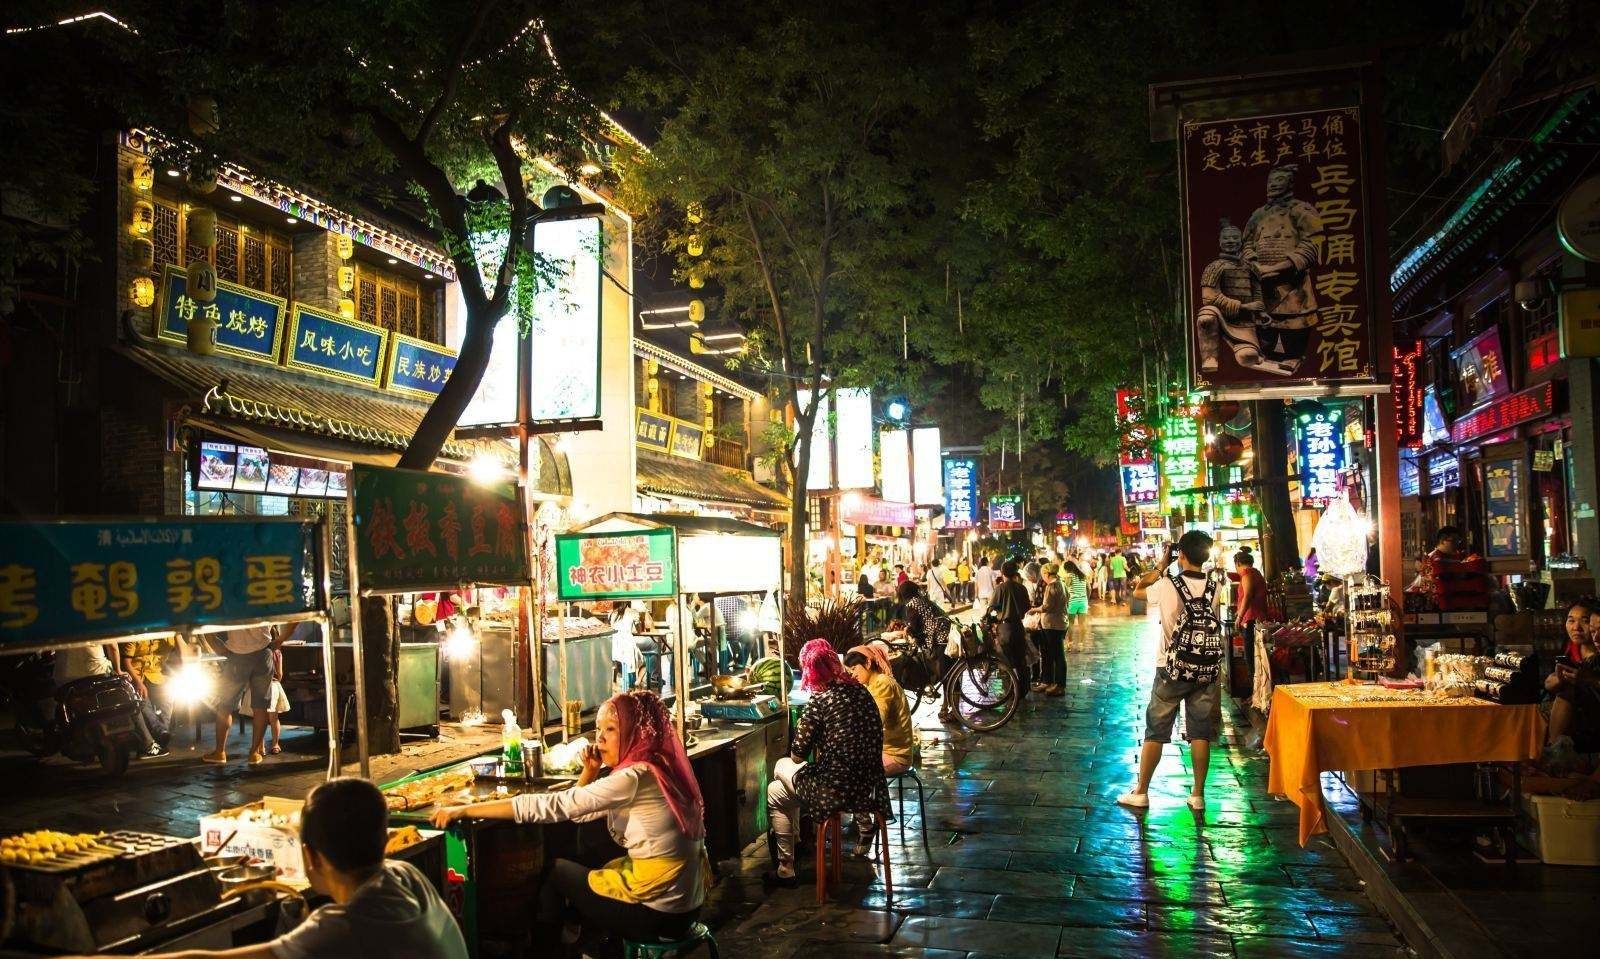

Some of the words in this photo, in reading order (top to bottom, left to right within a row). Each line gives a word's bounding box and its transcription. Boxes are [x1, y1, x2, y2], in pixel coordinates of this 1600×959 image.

[1202, 114, 1345, 146] 西安市兵马俑
[1202, 141, 1347, 172] 定点生产单位
[1311, 165, 1361, 373] 兵马俑专卖馆
[175, 294, 268, 338] 特色烧烤
[300, 330, 371, 366] 风味小吃
[570, 562, 663, 584] 神农小土豆
